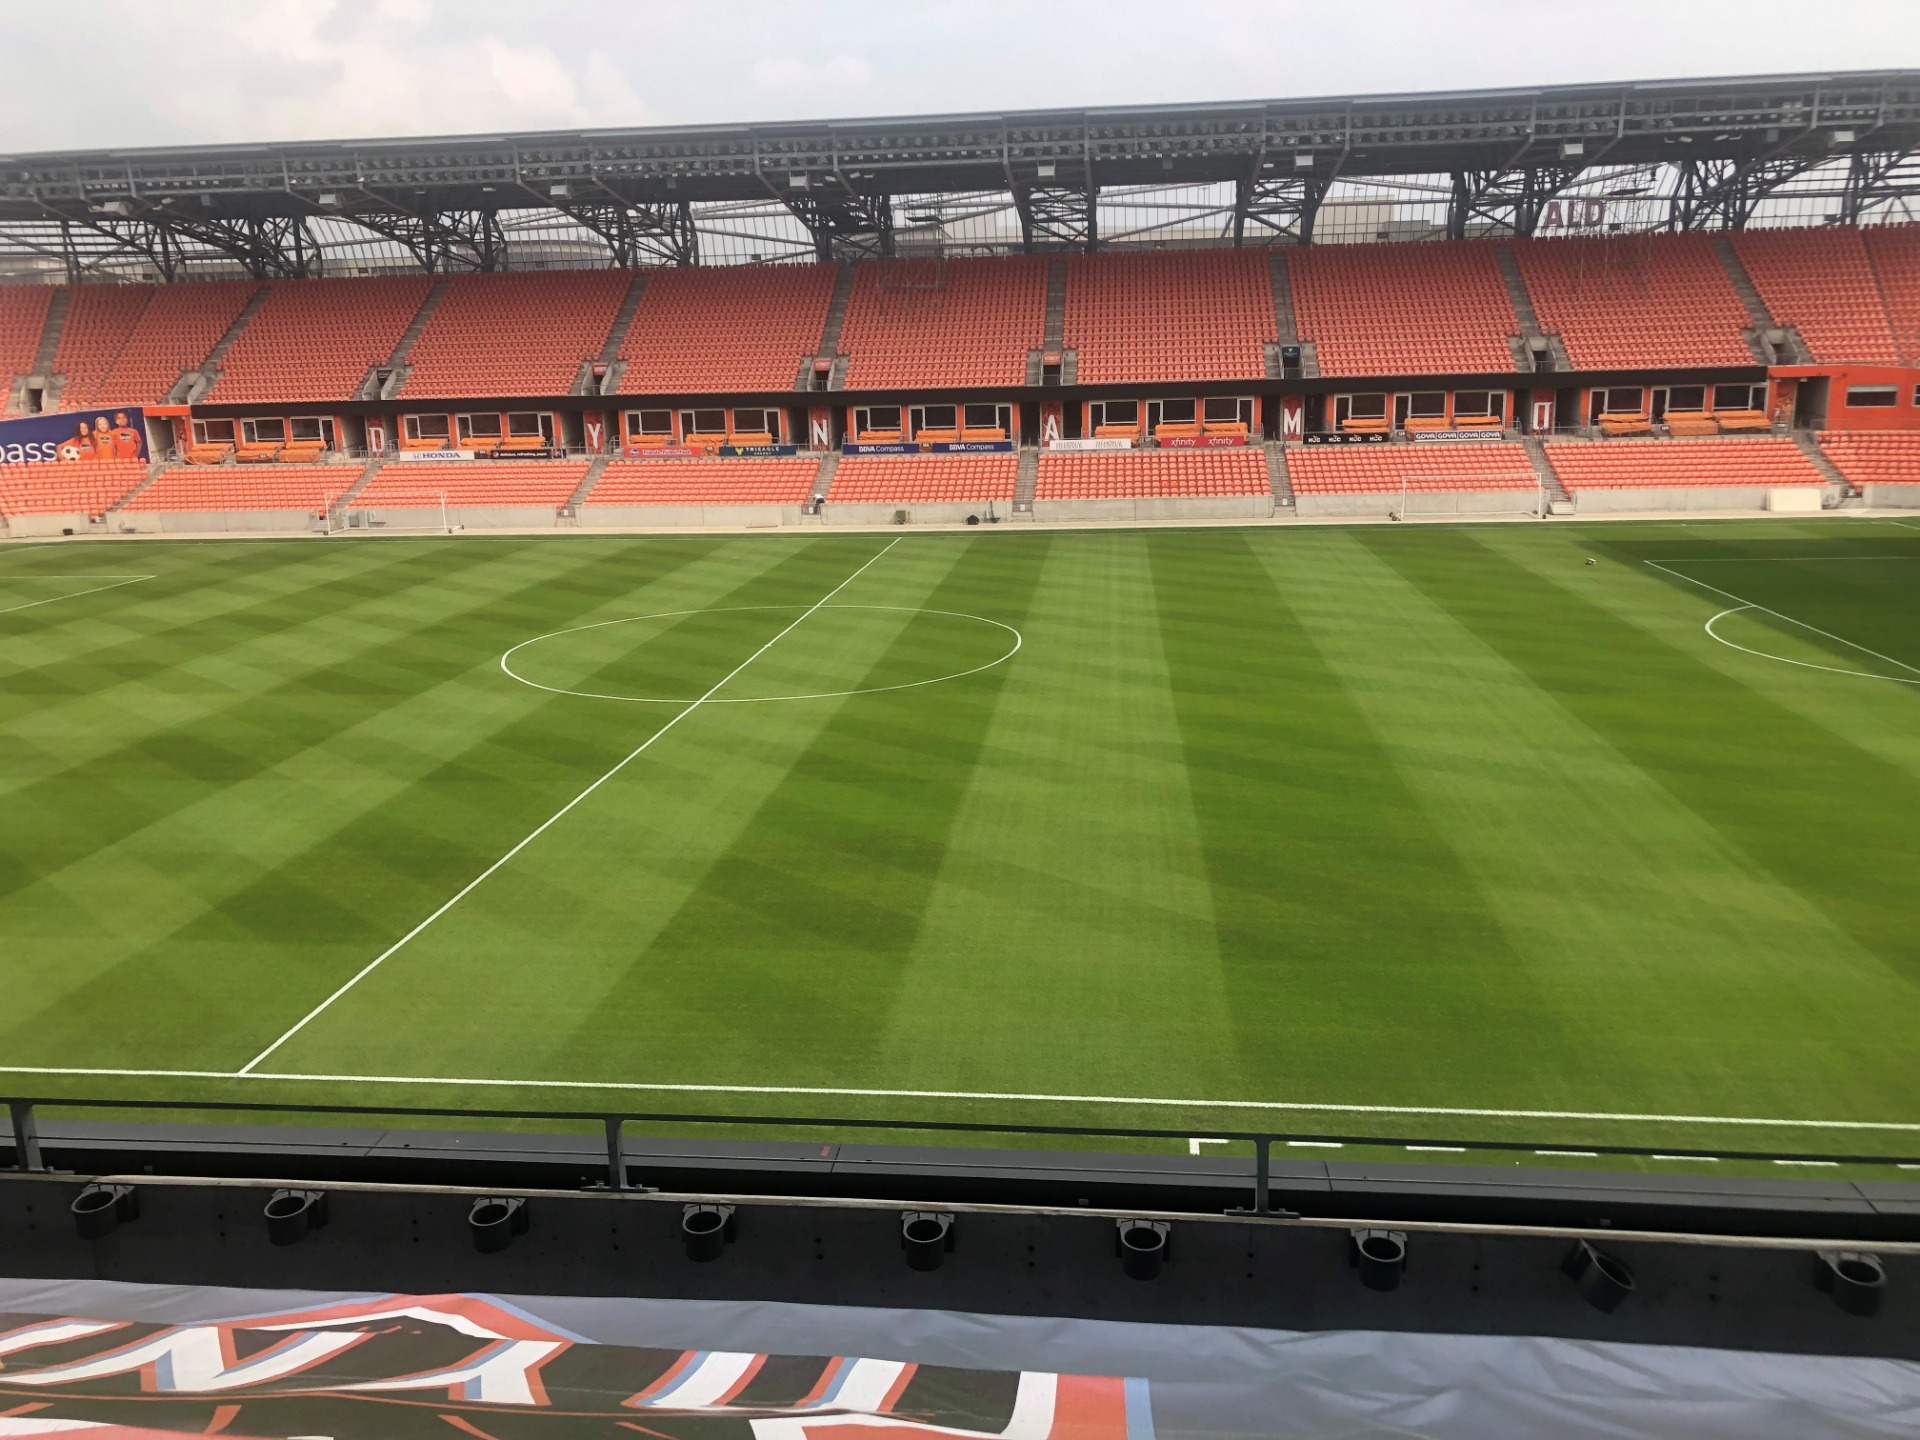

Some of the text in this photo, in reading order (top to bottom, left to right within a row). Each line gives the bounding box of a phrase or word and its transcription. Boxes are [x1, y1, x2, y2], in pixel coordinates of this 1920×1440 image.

[1415, 432, 1436, 440] GOYA
[1459, 431, 1479, 439] GOYA
[1170, 437, 1197, 447] xfinity
[1208, 436, 1234, 447] xfinity
[876, 445, 905, 453] Compass
[966, 443, 995, 451] Compass
